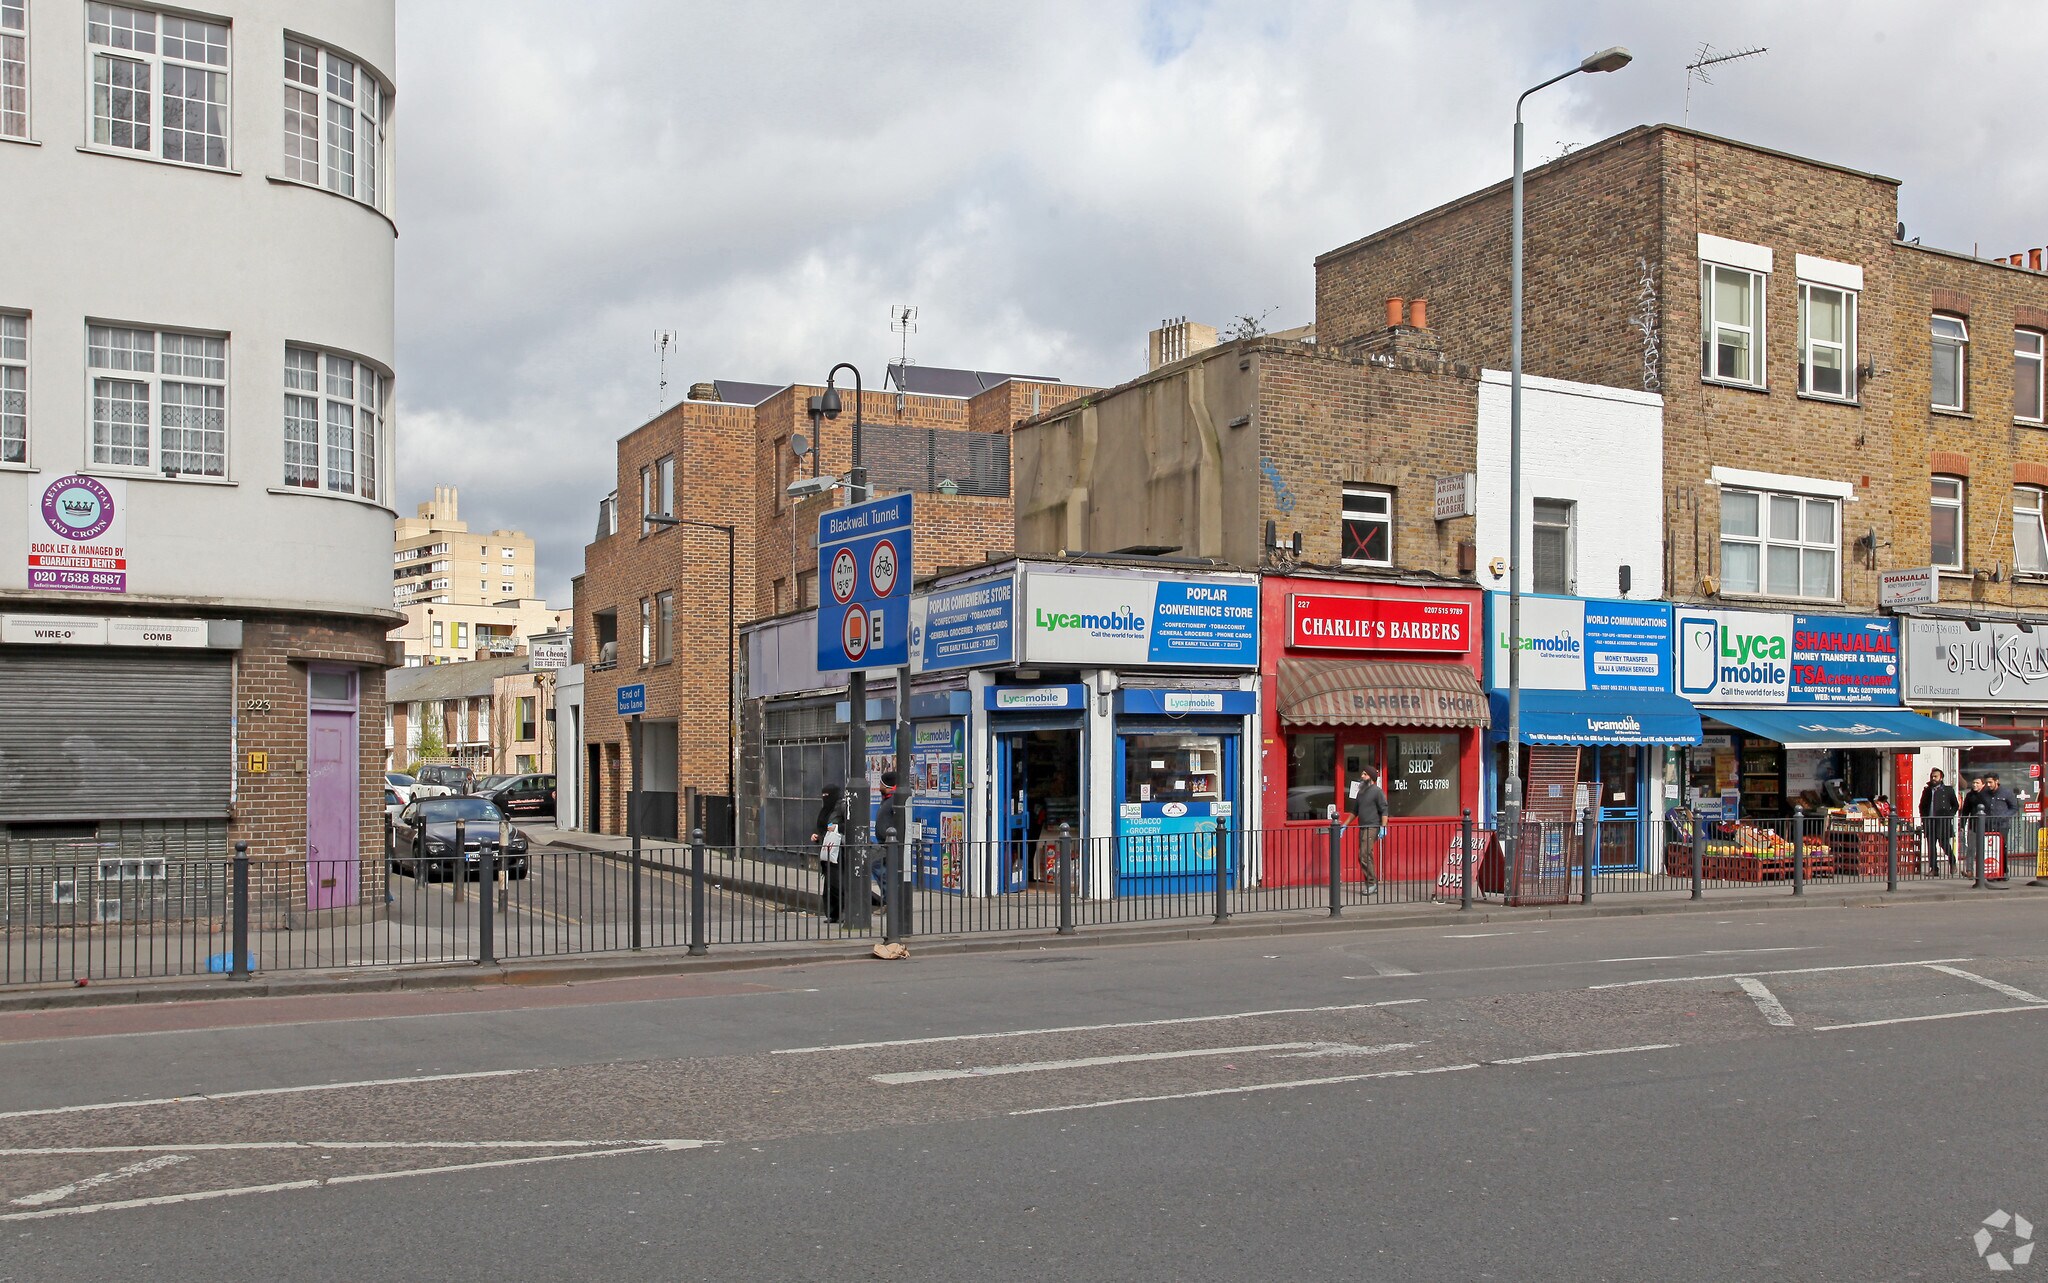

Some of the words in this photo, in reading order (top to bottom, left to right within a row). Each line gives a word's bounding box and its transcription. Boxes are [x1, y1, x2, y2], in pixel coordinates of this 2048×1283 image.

[45, 477, 111, 511] METROPOLITAN
[1437, 494, 1465, 506] CHARLIES
[1437, 503, 1464, 515] BARBERS
[830, 512, 869, 534] Blackwall
[871, 505, 900, 525] Tunnel
[49, 517, 68, 535] AND
[72, 519, 107, 538] CROWN
[31, 543, 56, 555] BLOCK
[56, 544, 70, 555] LET
[71, 545, 77, 555] &
[78, 546, 114, 557] MANAGED
[115, 547, 124, 557] BY
[40, 556, 90, 568] GUARANTEED
[92, 558, 116, 569] RENTS
[837, 563, 853, 575] 4.7m
[34, 571, 57, 582] 020
[60, 572, 90, 583] 7538
[92, 573, 122, 585] 8887
[1884, 573, 1930, 583] SHAHJALAL
[929, 598, 951, 615] POPLAR
[951, 590, 990, 610] CONVENIENCE
[991, 585, 1011, 602] STORE
[1186, 587, 1227, 601] POPLAR
[1159, 603, 1222, 617] CONVENIENCE
[1224, 606, 1253, 618] STORE
[1297, 600, 1311, 609] 227
[1424, 606, 1438, 614] 0207
[1438, 607, 1449, 615] 515
[1449, 607, 1463, 615] 9789
[1036, 607, 1145, 632] Lycamobile
[1586, 615, 1609, 625] WORLD
[1610, 616, 1667, 627] COMMUNICATIONS
[872, 617, 881, 642] E
[1302, 617, 1386, 638] CHARLIE'S
[1390, 621, 1461, 641] BARBERS
[143, 633, 172, 641] COMB
[1500, 632, 1580, 652] Lcamobile
[1794, 630, 1897, 653] SHAHJALAL
[1721, 625, 1786, 665] Lyca
[1793, 652, 1819, 661] MONEY
[1820, 652, 1857, 663] TRANSFER
[1859, 654, 1865, 663] &
[1865, 654, 1897, 664] TRAVELS
[1720, 662, 1786, 685] mobile
[1793, 664, 1827, 685] TSA
[1827, 674, 1853, 686] CASH
[1853, 675, 1861, 686] &
[1861, 675, 1893, 686] CARRY
[622, 690, 632, 699] End
[633, 688, 641, 697] of
[1720, 687, 1733, 696] Call
[1733, 688, 1743, 696] the
[1743, 688, 1762, 697] world
[1762, 689, 1772, 697] for
[1771, 689, 1785, 697] less
[1913, 684, 1928, 695] Grill
[1929, 685, 1960, 695] Restaurant
[1003, 694, 1058, 704] Lycamobile
[1170, 698, 1215, 708] Lycamobile
[1353, 694, 1421, 709] BARBER
[1438, 696, 1474, 712] SHOP
[1814, 693, 1830, 701] WEB:
[246, 700, 271, 711] 223
[619, 702, 629, 710] bus
[630, 700, 643, 709] lane
[1587, 715, 1641, 731] Lycamobile
[866, 730, 890, 744] camobile
[916, 728, 950, 744] Lycamobile
[1400, 741, 1442, 755] BARBER
[251, 754, 265, 771] H
[1408, 759, 1434, 774] SHOP
[1394, 779, 1408, 790] Tel:
[1418, 779, 1435, 790] 7515
[1434, 779, 1450, 790] 9789
[1127, 805, 1141, 813] Lyca
[1129, 817, 1162, 825] TOBACCO
[1450, 836, 1487, 851] BABER
[1447, 852, 1478, 866] SHP
[1438, 872, 1463, 889] OPE
